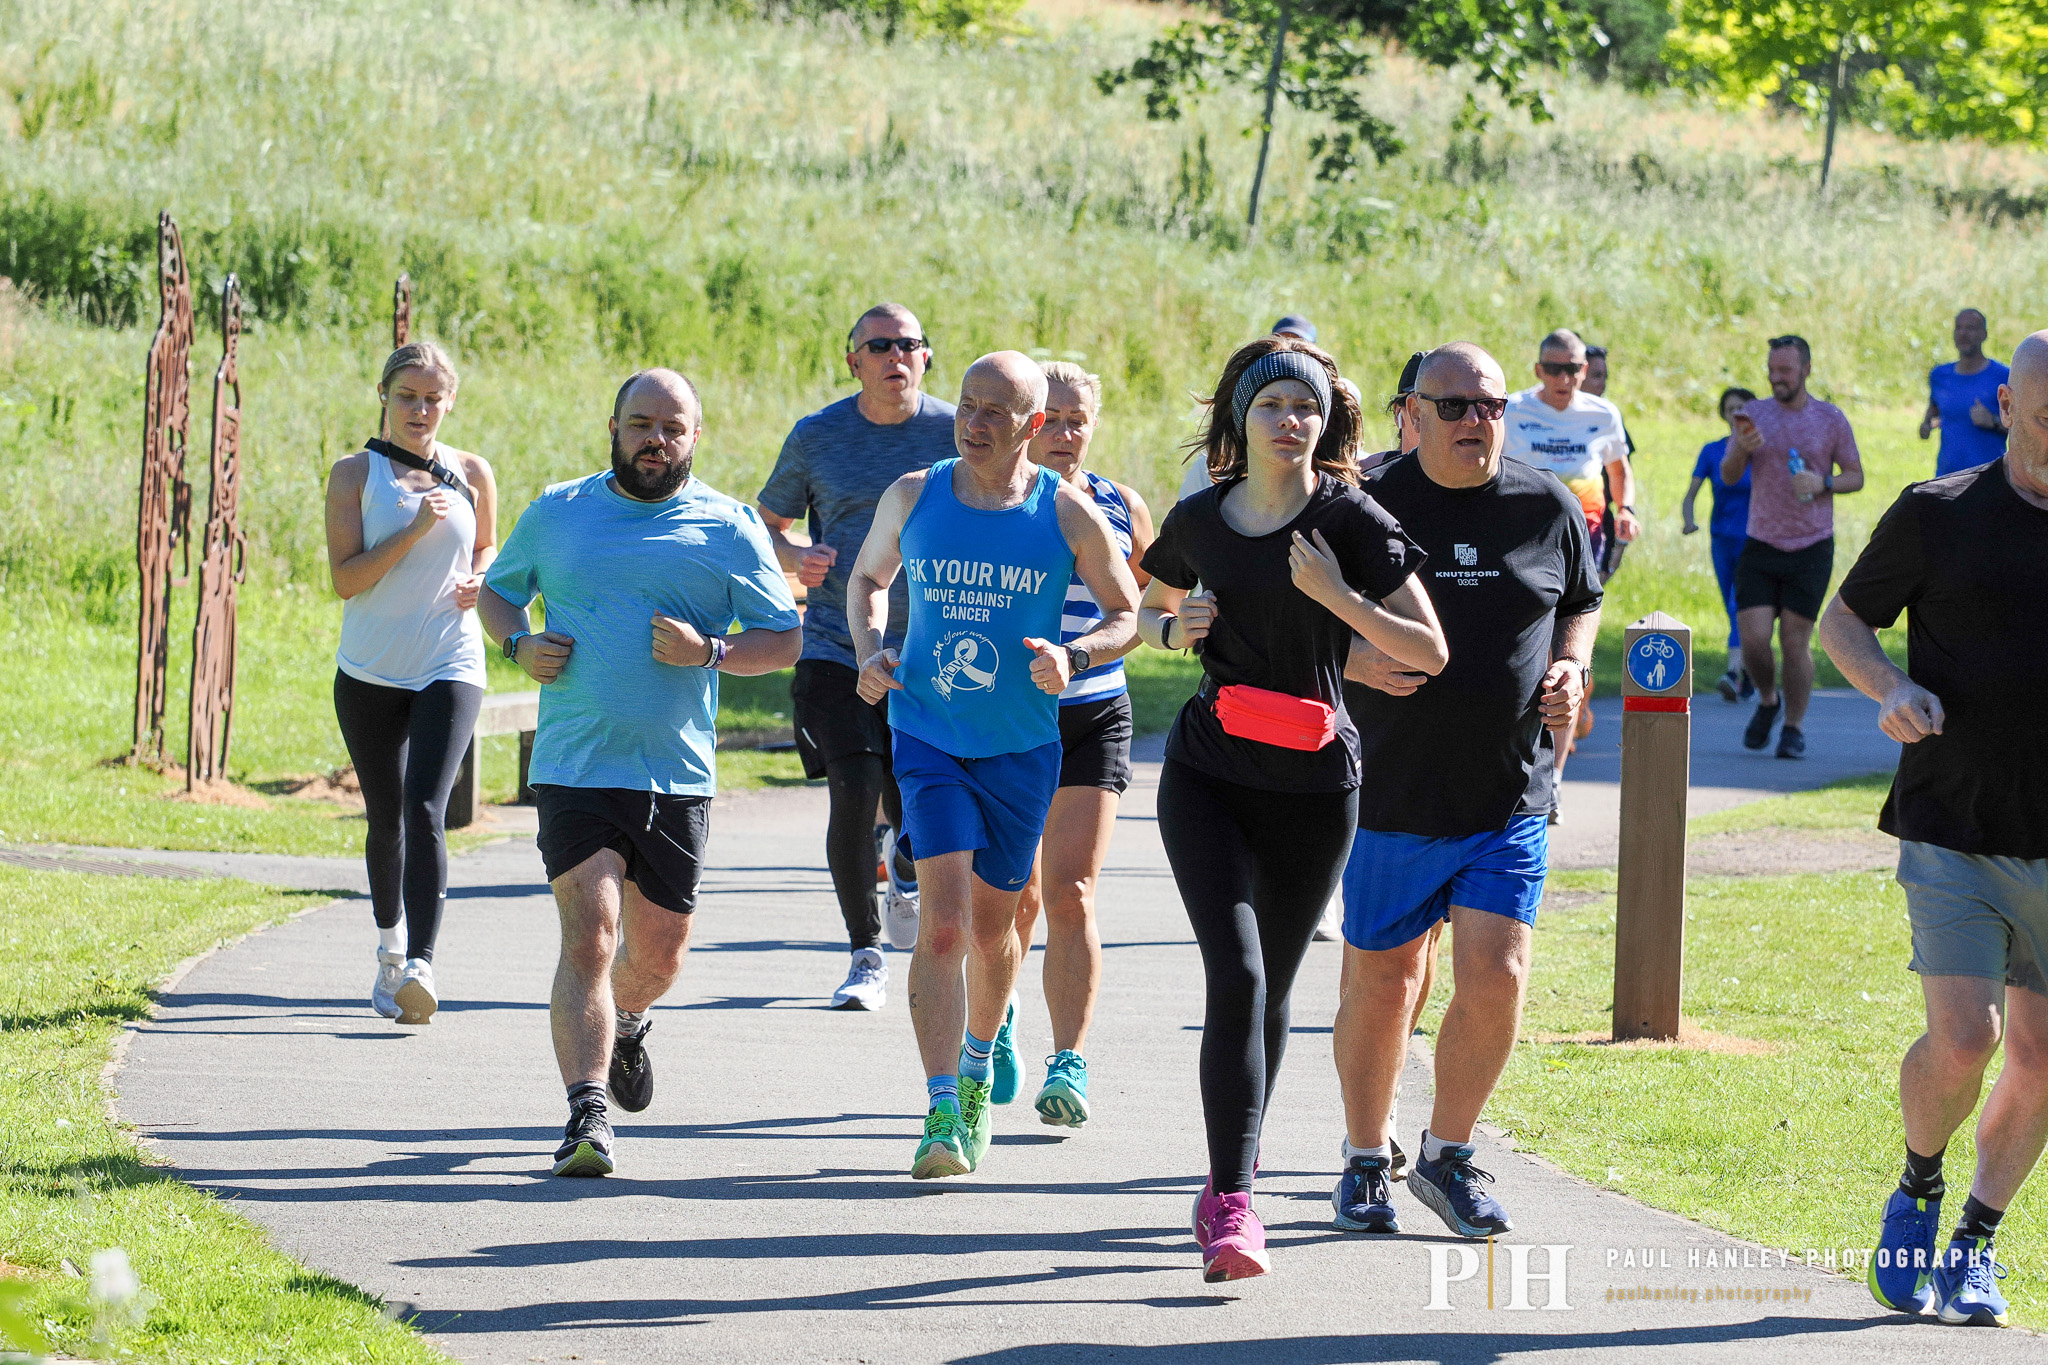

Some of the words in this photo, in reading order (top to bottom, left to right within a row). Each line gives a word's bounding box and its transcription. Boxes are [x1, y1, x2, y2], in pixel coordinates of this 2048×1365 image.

[1459, 547, 1478, 556] RUN
[909, 558, 928, 583] 5K
[932, 559, 994, 587] YOUR
[1000, 564, 1048, 595] WAY
[1435, 570, 1500, 578] KNUTSFORD
[1457, 578, 1479, 586] 10K
[924, 587, 955, 603] MOVE
[958, 590, 1013, 609] AGAINST
[942, 605, 990, 622] CANCER
[932, 640, 945, 657] 5K
[943, 630, 968, 646] Your
[939, 655, 973, 688] MOVE
